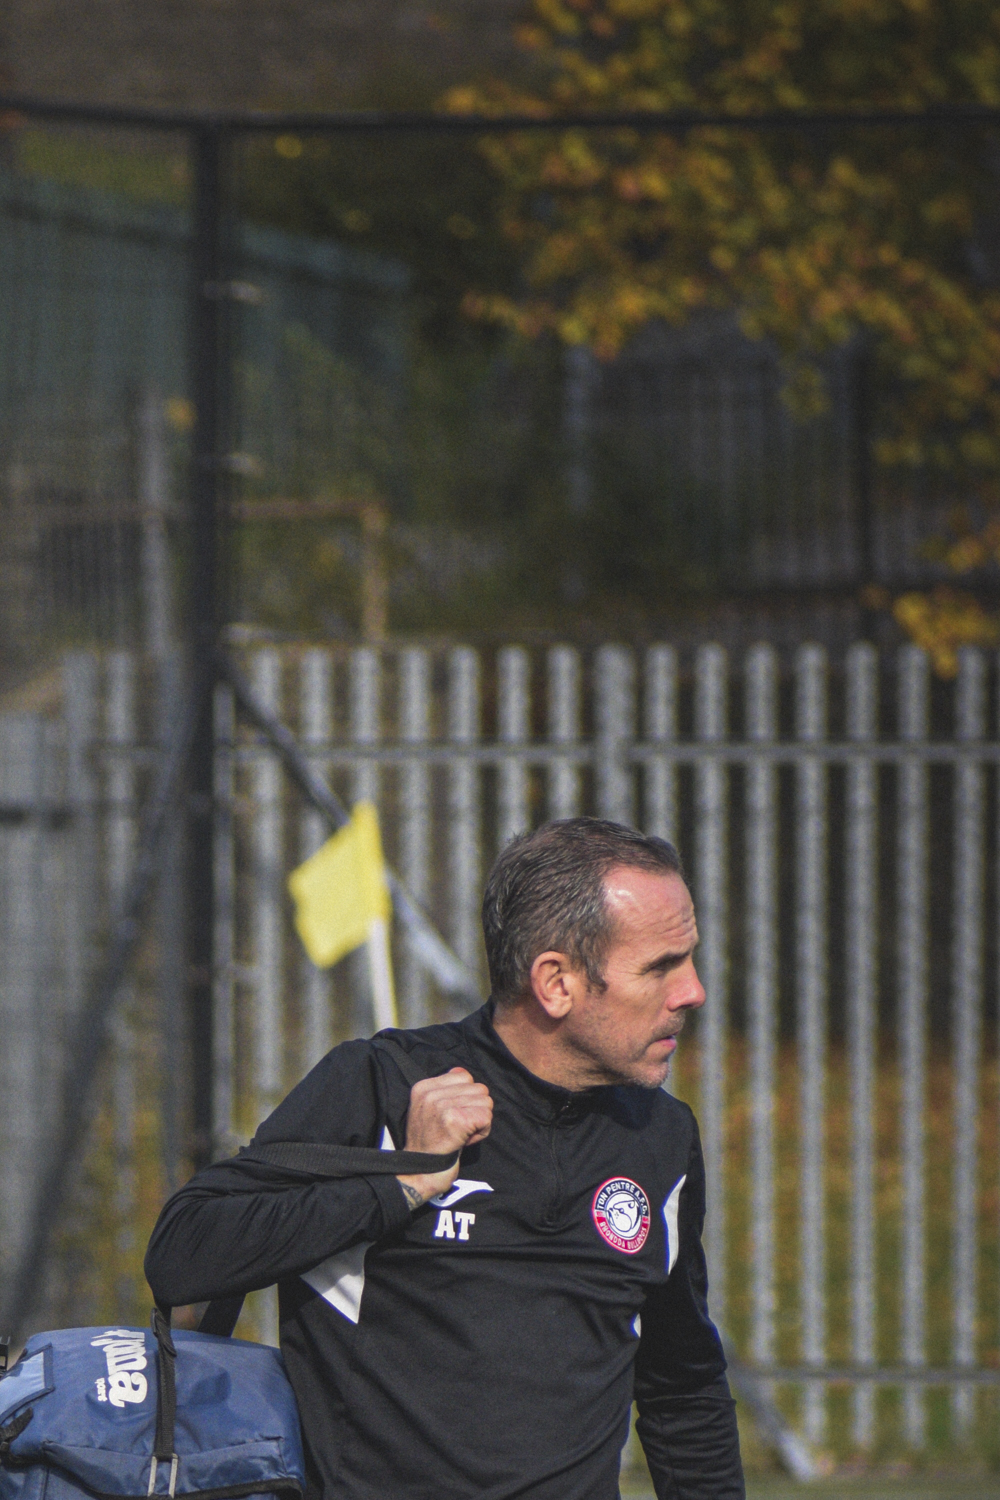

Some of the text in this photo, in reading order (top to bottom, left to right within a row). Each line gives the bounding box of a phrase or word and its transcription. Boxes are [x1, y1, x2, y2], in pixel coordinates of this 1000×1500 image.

[597, 1192, 608, 1211] TON
[606, 1181, 635, 1194] PENTRE
[433, 1209, 476, 1241] AT
[600, 1221, 626, 1248] RHONDDA
